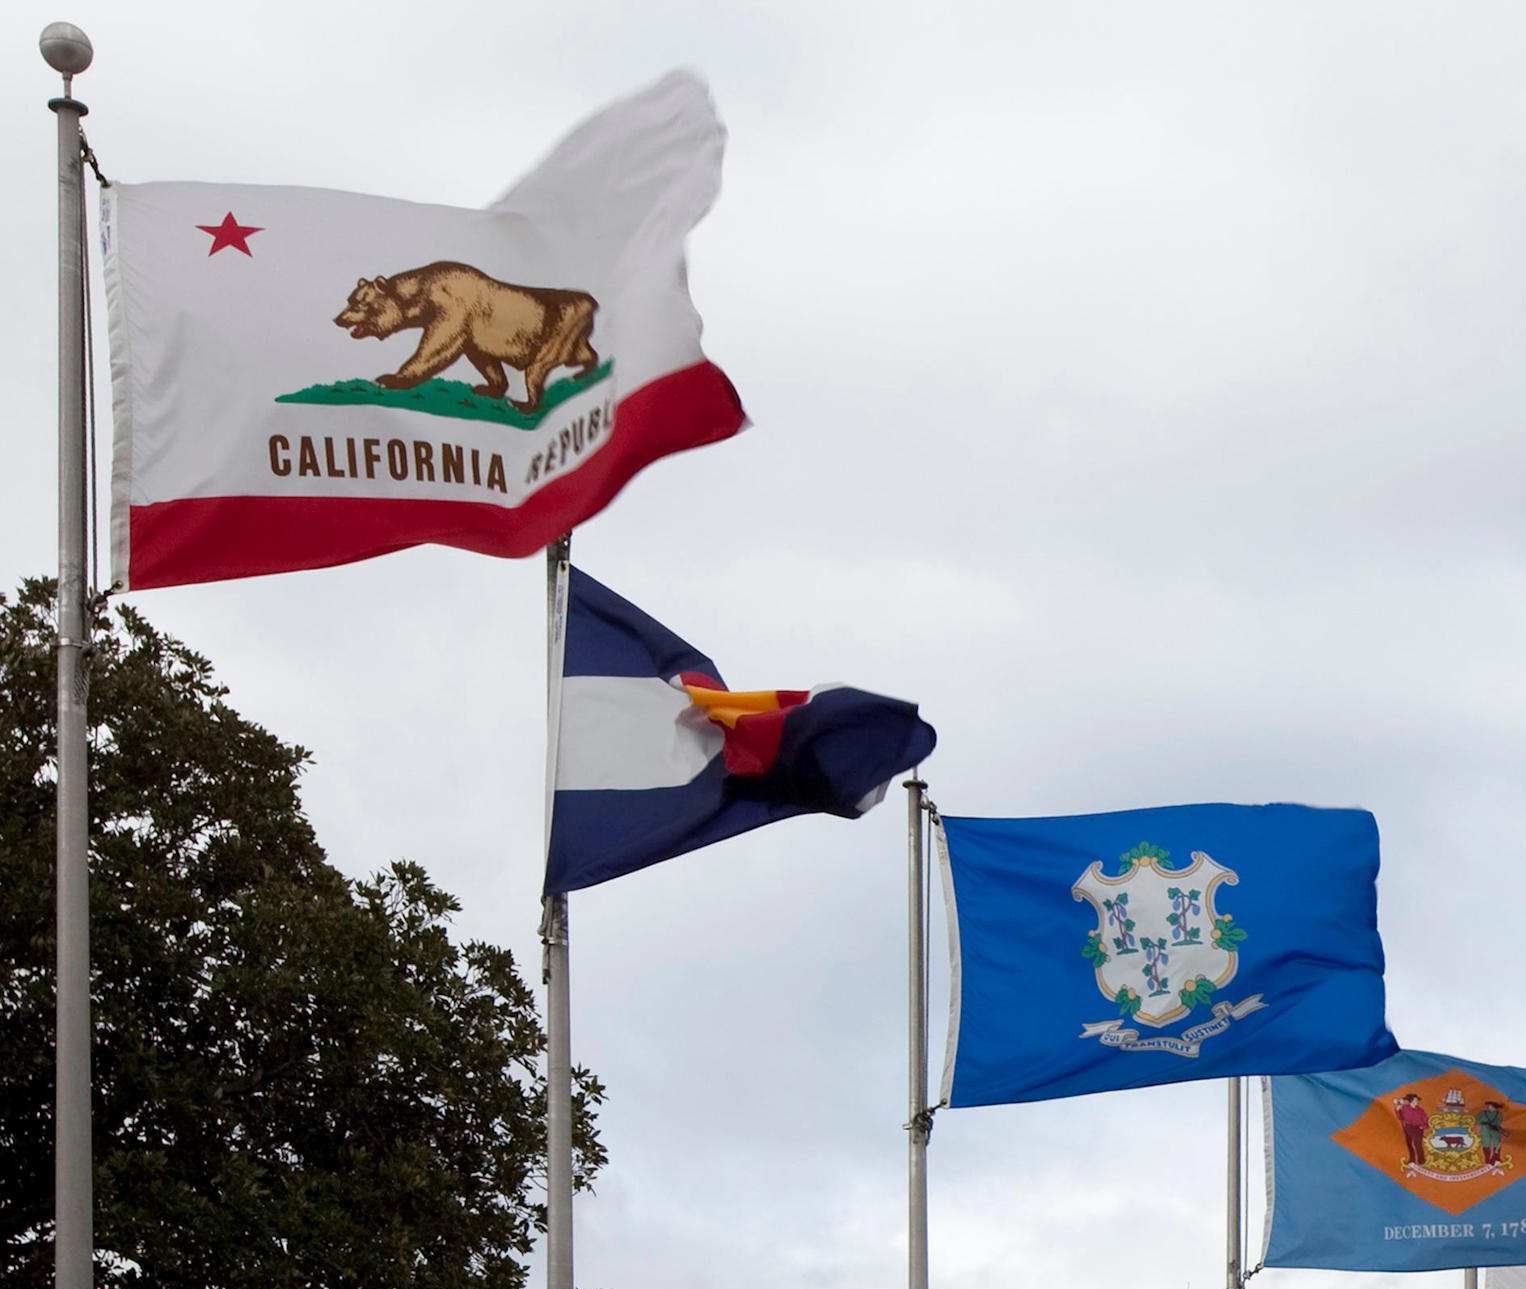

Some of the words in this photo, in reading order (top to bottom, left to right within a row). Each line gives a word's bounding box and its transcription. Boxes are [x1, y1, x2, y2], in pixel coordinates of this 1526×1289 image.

[269, 434, 508, 494] CALIFORNIA
[525, 398, 613, 484] REPUBL
[1384, 1223, 1475, 1241] DECEMBER
[1482, 1223, 1495, 1240] 7,
